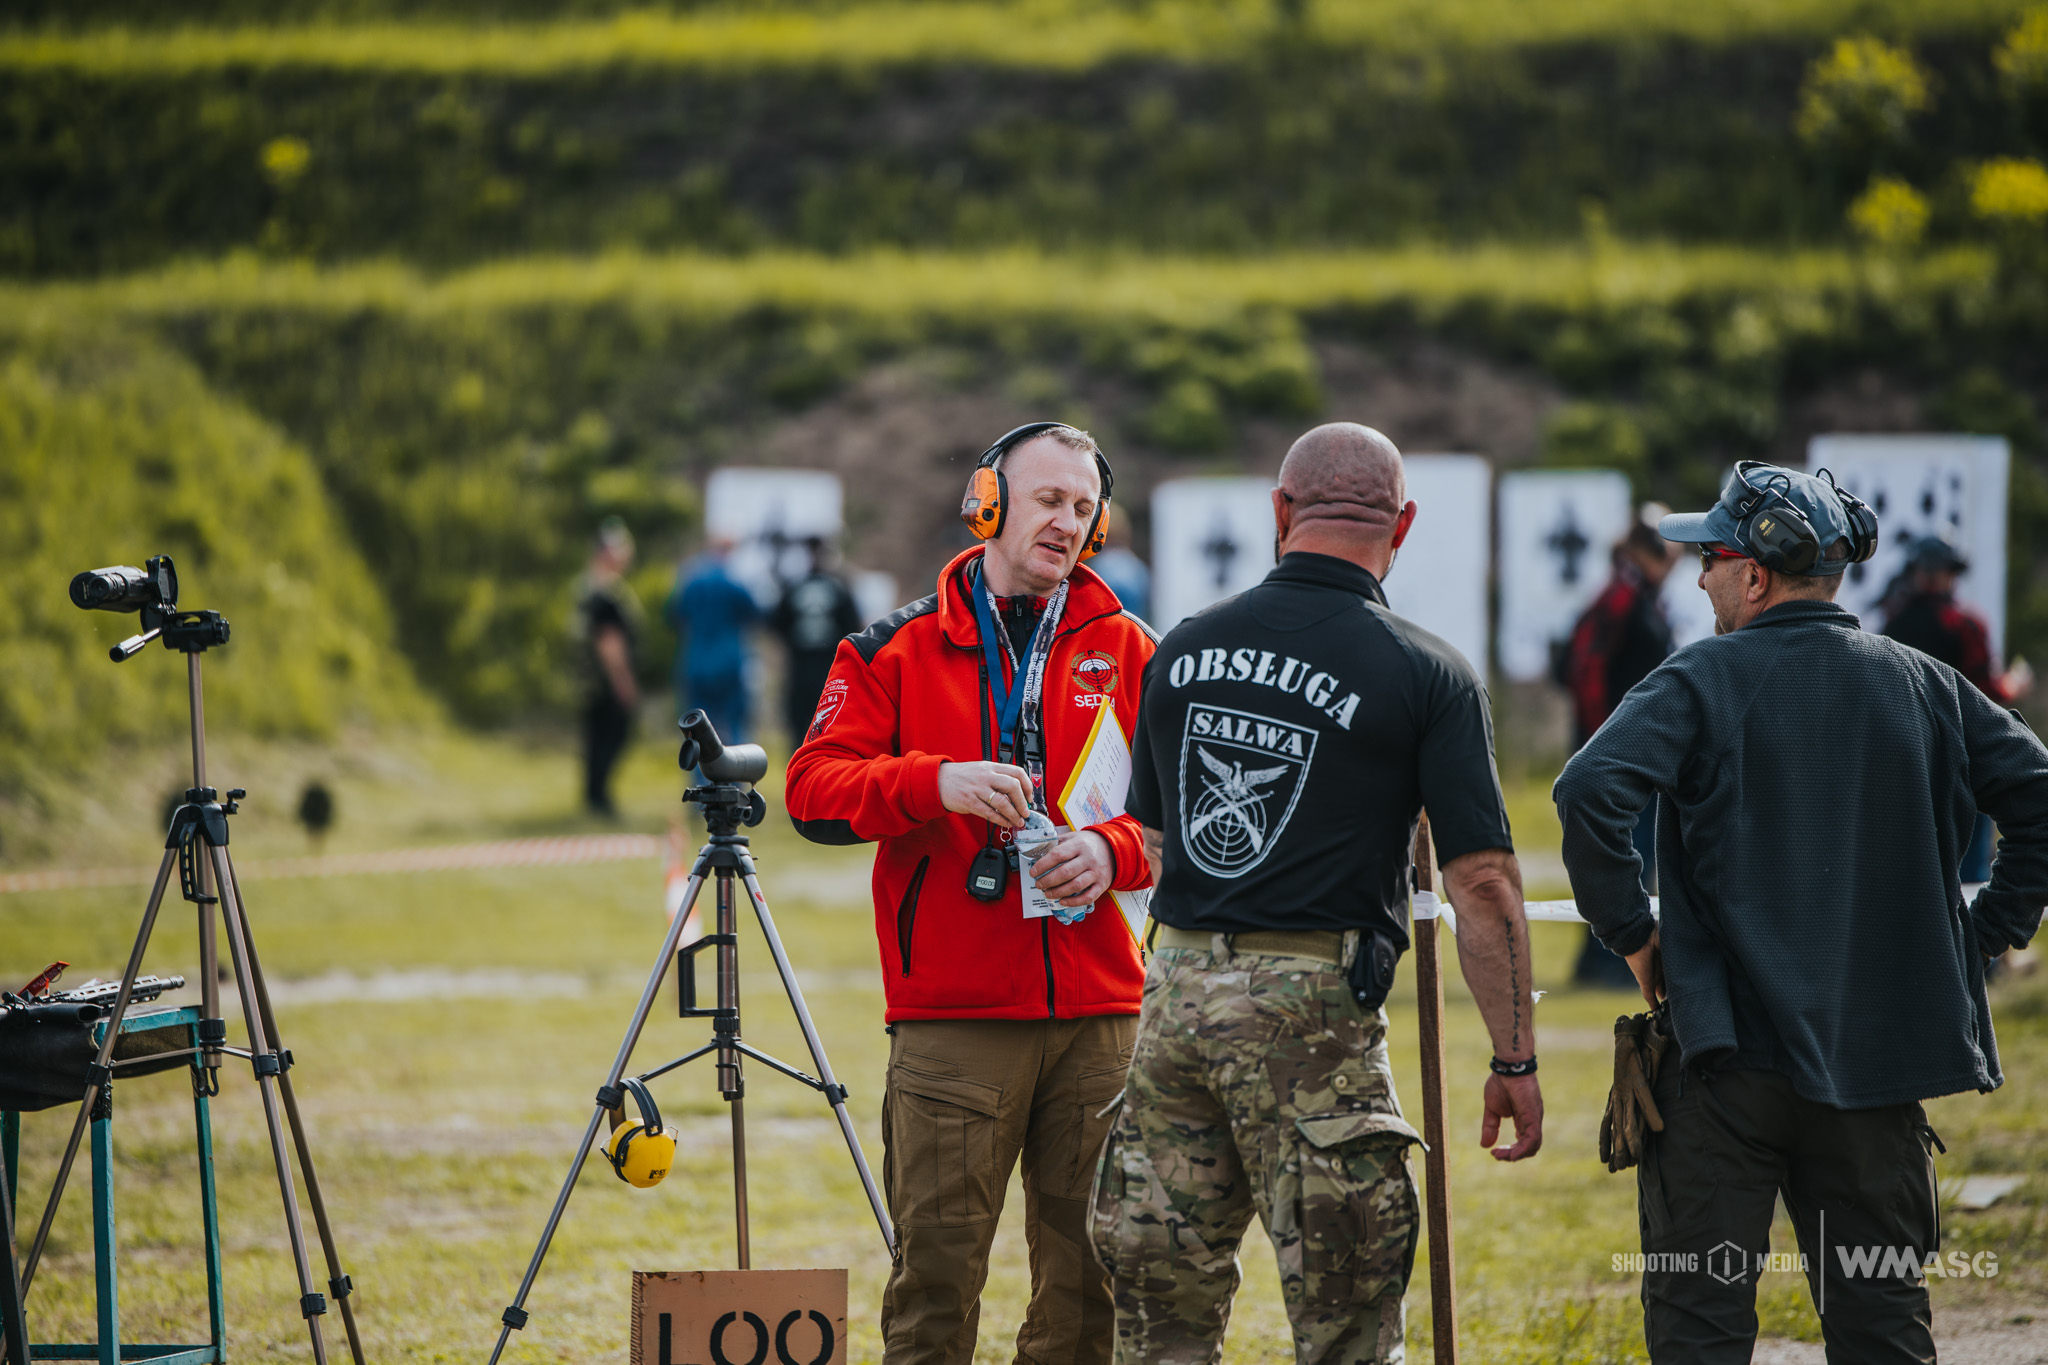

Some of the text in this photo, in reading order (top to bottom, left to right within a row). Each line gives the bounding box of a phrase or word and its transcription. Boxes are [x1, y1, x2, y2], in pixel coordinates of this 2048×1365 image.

[1087, 649, 1095, 657] P
[1113, 665, 1119, 674] S
[1096, 685, 1104, 693] S
[1168, 648, 1361, 730] OBSŁUGA
[1192, 711, 1304, 757] SALWA
